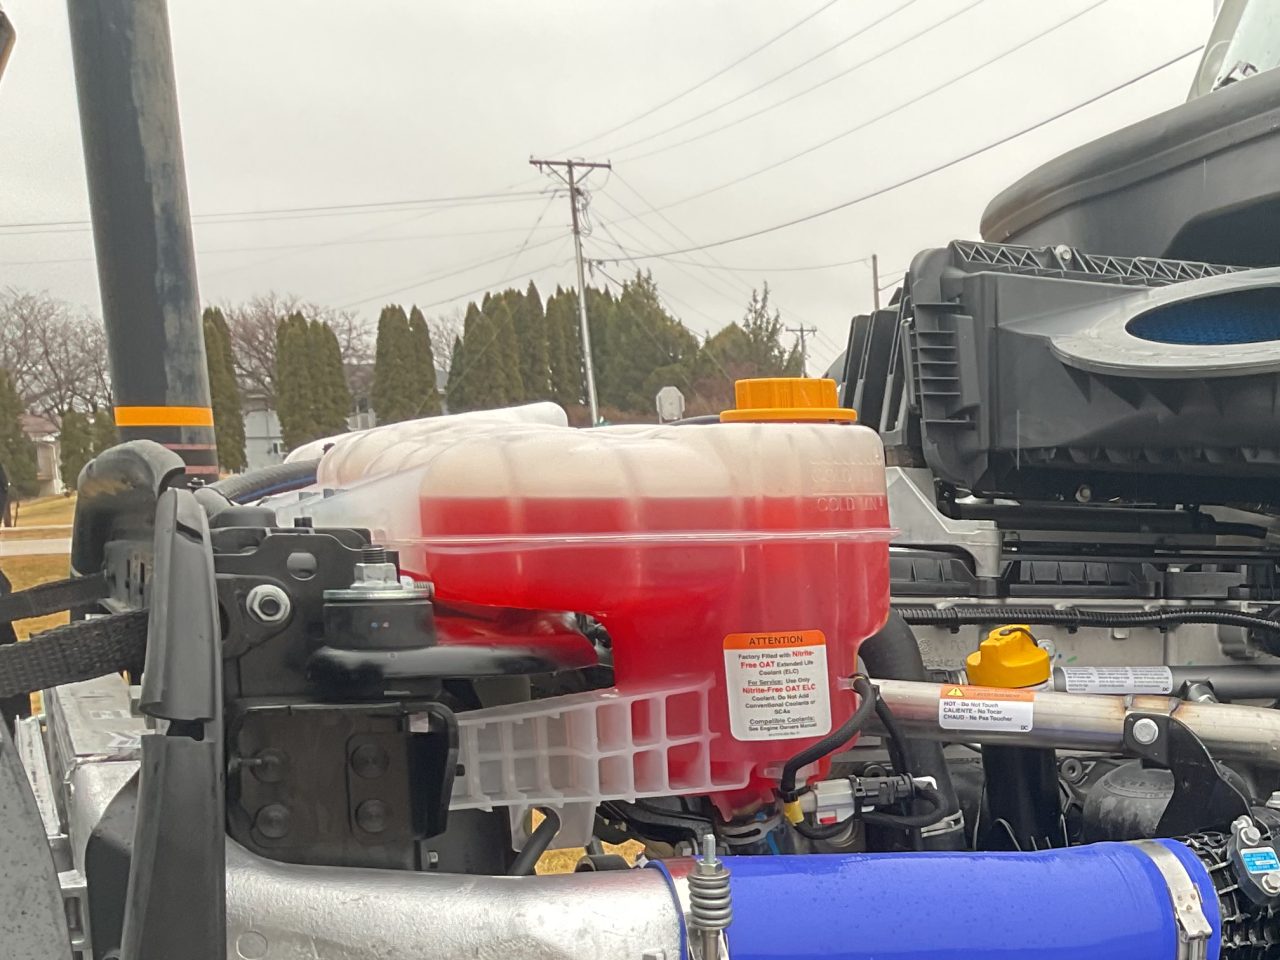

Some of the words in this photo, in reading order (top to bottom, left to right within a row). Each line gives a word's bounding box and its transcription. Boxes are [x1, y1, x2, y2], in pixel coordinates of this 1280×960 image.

[817, 497, 856, 512] COLD
[749, 635, 804, 646] ATTENTION
[738, 653, 760, 661] Factory
[783, 668, 799, 676] (ELC)
[743, 686, 783, 694] Nitrite-Free
[786, 684, 800, 692] OAT
[802, 683, 816, 691] ELC
[745, 701, 783, 709] Conventional
[750, 718, 785, 726] Compatible
